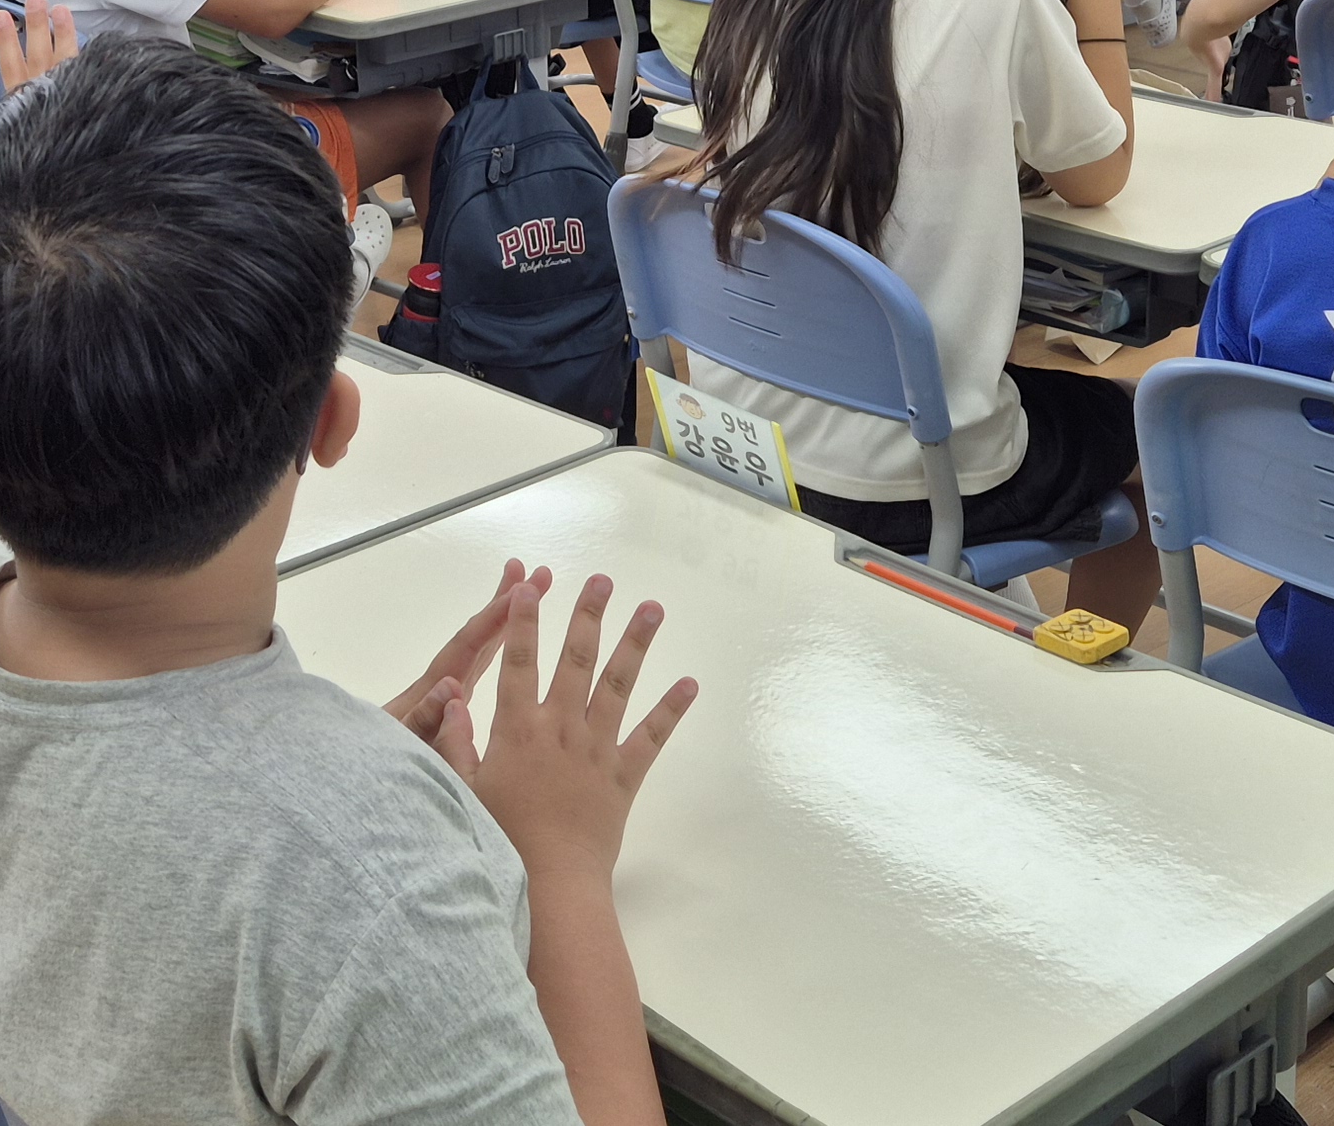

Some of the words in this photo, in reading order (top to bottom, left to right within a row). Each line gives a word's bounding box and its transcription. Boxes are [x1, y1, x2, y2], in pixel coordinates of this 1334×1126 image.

[497, 217, 586, 269] POLO
[519, 259, 544, 274] Ralph
[720, 411, 759, 447] 9번
[675, 418, 774, 487] 강윤우
